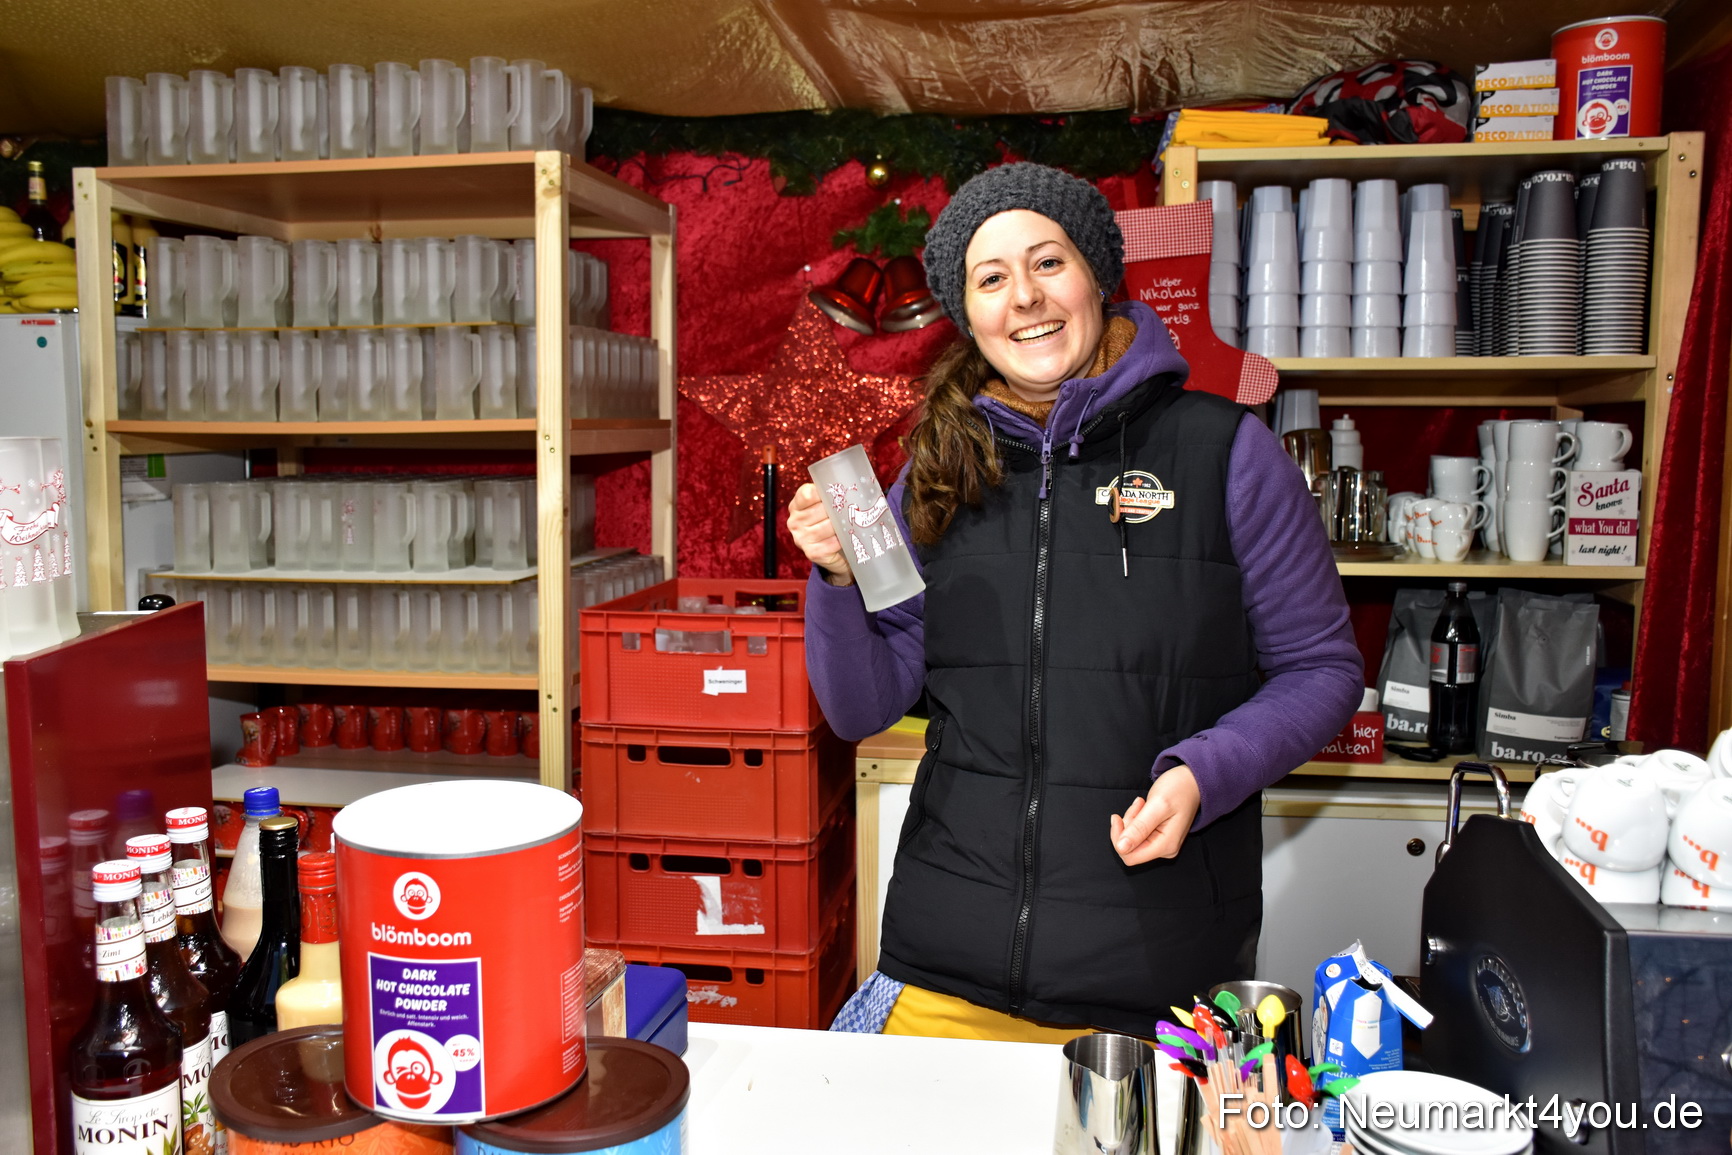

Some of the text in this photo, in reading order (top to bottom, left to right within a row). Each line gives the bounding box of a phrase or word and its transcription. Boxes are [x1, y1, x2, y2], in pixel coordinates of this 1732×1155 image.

[1582, 53, 1630, 64] blömboom
[1476, 74, 1556, 88] DECORATION
[1594, 76, 1628, 84] CHOCOLATE
[1592, 83, 1617, 91] POWDER
[1480, 103, 1559, 115] DECORATION
[1476, 130, 1553, 140] DECORATION
[1153, 277, 1181, 287] Lieber
[1140, 287, 1197, 300] Nikolaus
[1178, 303, 1200, 312] ganz
[1161, 314, 1190, 325] artig
[1138, 490, 1169, 500] NORTH
[1577, 478, 1630, 507] Santa
[1595, 499, 1623, 511] knows
[1574, 520, 1630, 534] what You did
[1579, 544, 1596, 554] last
[1494, 712, 1516, 721] Simba
[1353, 723, 1379, 738] hier
[178, 812, 207, 825] MONIN
[371, 922, 471, 946] blömboom
[102, 949, 121, 958] Zimt
[402, 968, 437, 981] DARK
[376, 979, 471, 996] HOT CHOCOLATE
[395, 997, 448, 1011] POWDER
[380, 1009, 396, 1017] Ehrlich
[452, 1048, 475, 1057] 45%
[78, 1114, 169, 1145] MONIN
